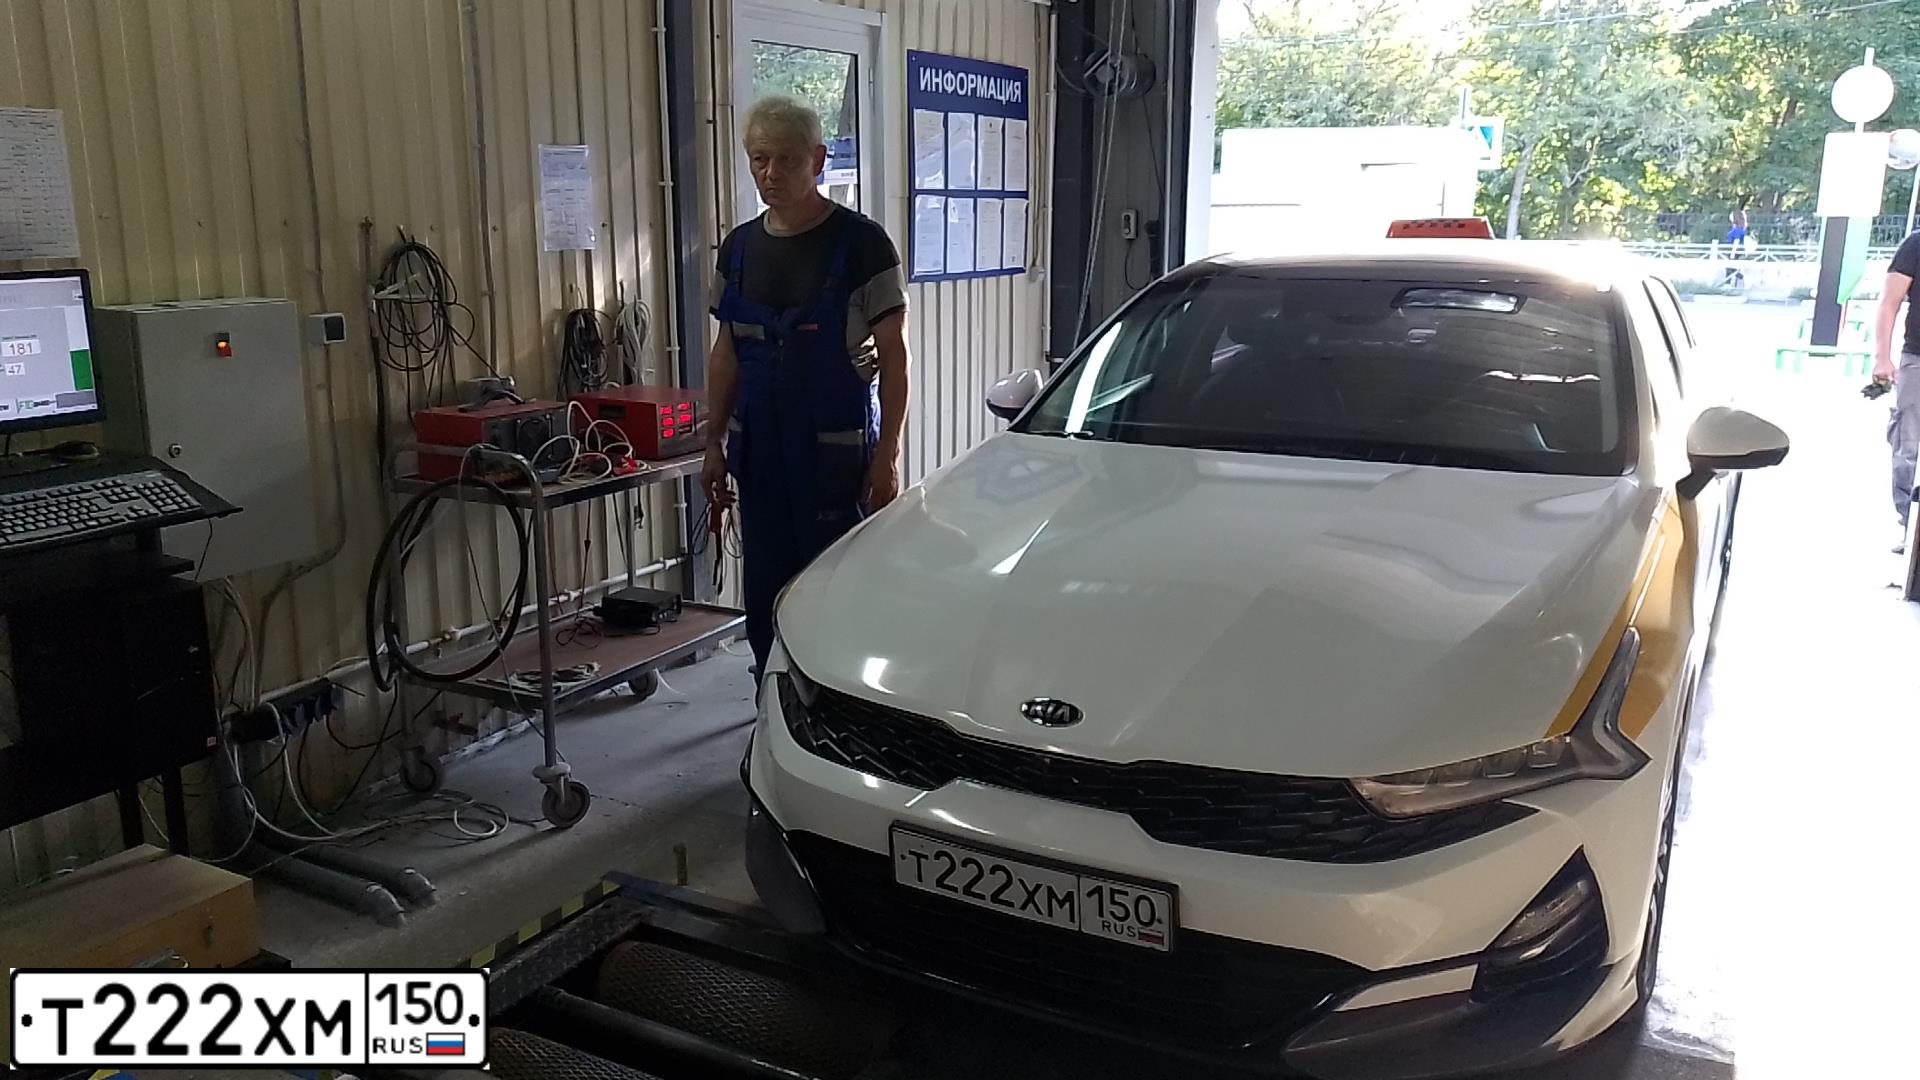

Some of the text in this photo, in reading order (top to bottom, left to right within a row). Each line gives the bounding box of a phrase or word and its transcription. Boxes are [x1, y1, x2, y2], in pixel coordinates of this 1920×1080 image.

[919, 66, 1022, 105] ИНФОРМАЦИЯ
[9, 342, 33, 356] 181
[908, 849, 1157, 928] Т222ХМ 150
[1101, 919, 1137, 938] RUS
